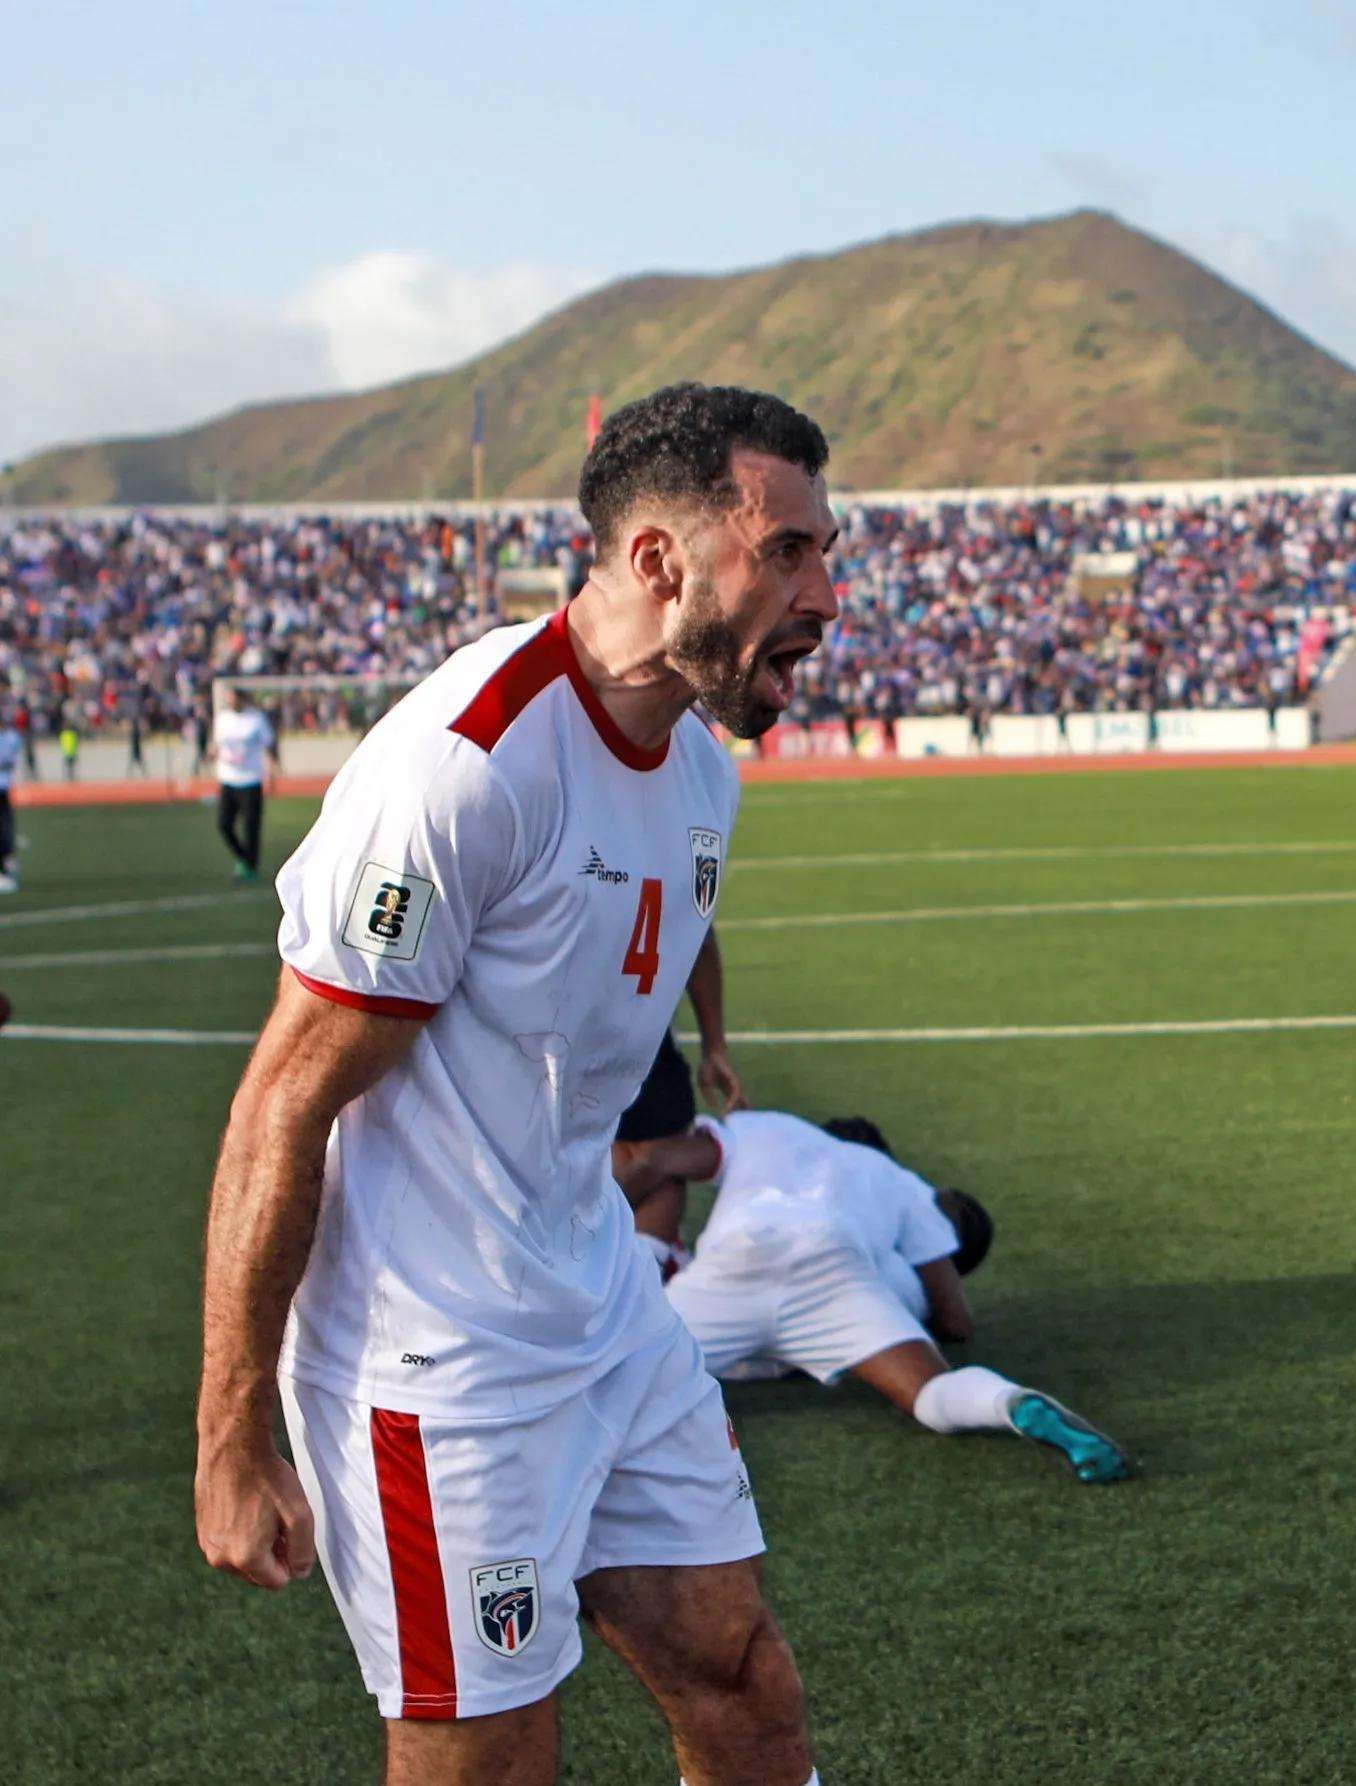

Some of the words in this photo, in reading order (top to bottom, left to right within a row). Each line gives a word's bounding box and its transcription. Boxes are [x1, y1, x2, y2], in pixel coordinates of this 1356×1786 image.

[692, 833, 718, 848] FCF
[597, 869, 629, 885] tempo
[621, 877, 663, 995] 4
[476, 1564, 531, 1586] FCF
